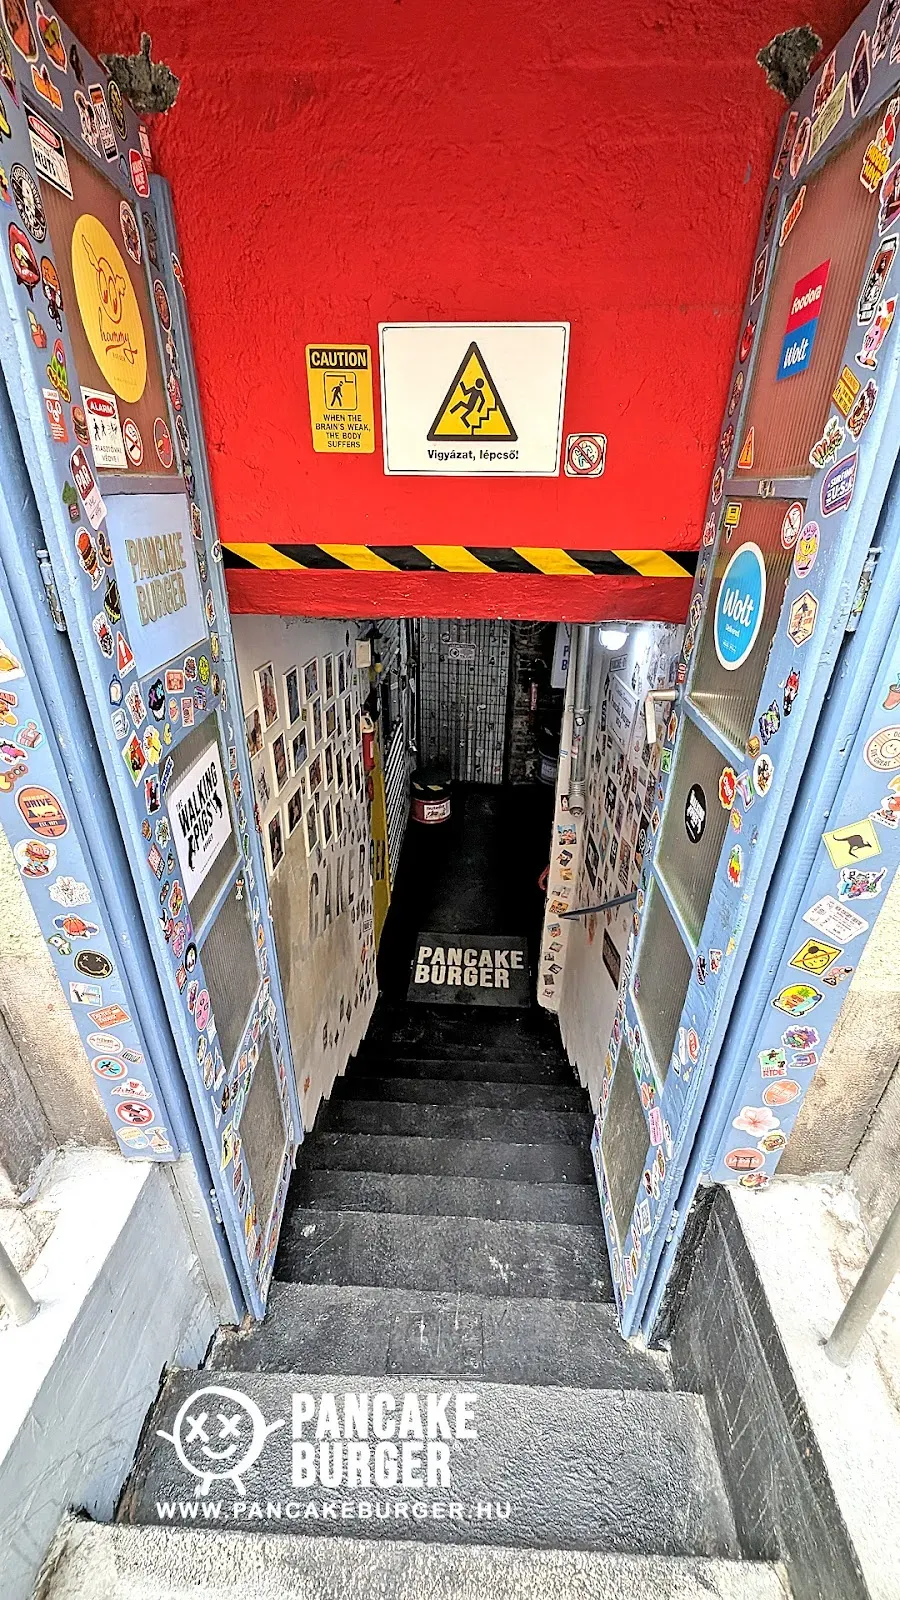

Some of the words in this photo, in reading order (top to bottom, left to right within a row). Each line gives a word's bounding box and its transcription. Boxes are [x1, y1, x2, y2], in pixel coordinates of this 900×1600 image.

[791, 285, 823, 315] foodora
[311, 351, 367, 367] CAUTION
[783, 337, 809, 369] Wolt
[89, 401, 114, 414] ALARM
[315, 423, 345, 431] BRAIN'S
[347, 423, 371, 432] WEAK,
[323, 414, 346, 422] WHEN
[347, 414, 362, 422] THE
[327, 440, 361, 448] SUFFERS
[342, 432, 362, 440] BODY
[427, 449, 476, 461] Vigyázat,
[479, 449, 519, 461] lépcső!
[124, 531, 187, 584] PANCAKE
[135, 572, 187, 626] BURGER
[722, 587, 754, 628] Wolt
[23, 798, 53, 809] DRIVE
[178, 761, 218, 838] WALKING
[193, 801, 214, 850] PIGS
[417, 945, 525, 970] PANCAKE
[414, 964, 510, 989] BURGER
[763, 1069, 785, 1077] RIDE
